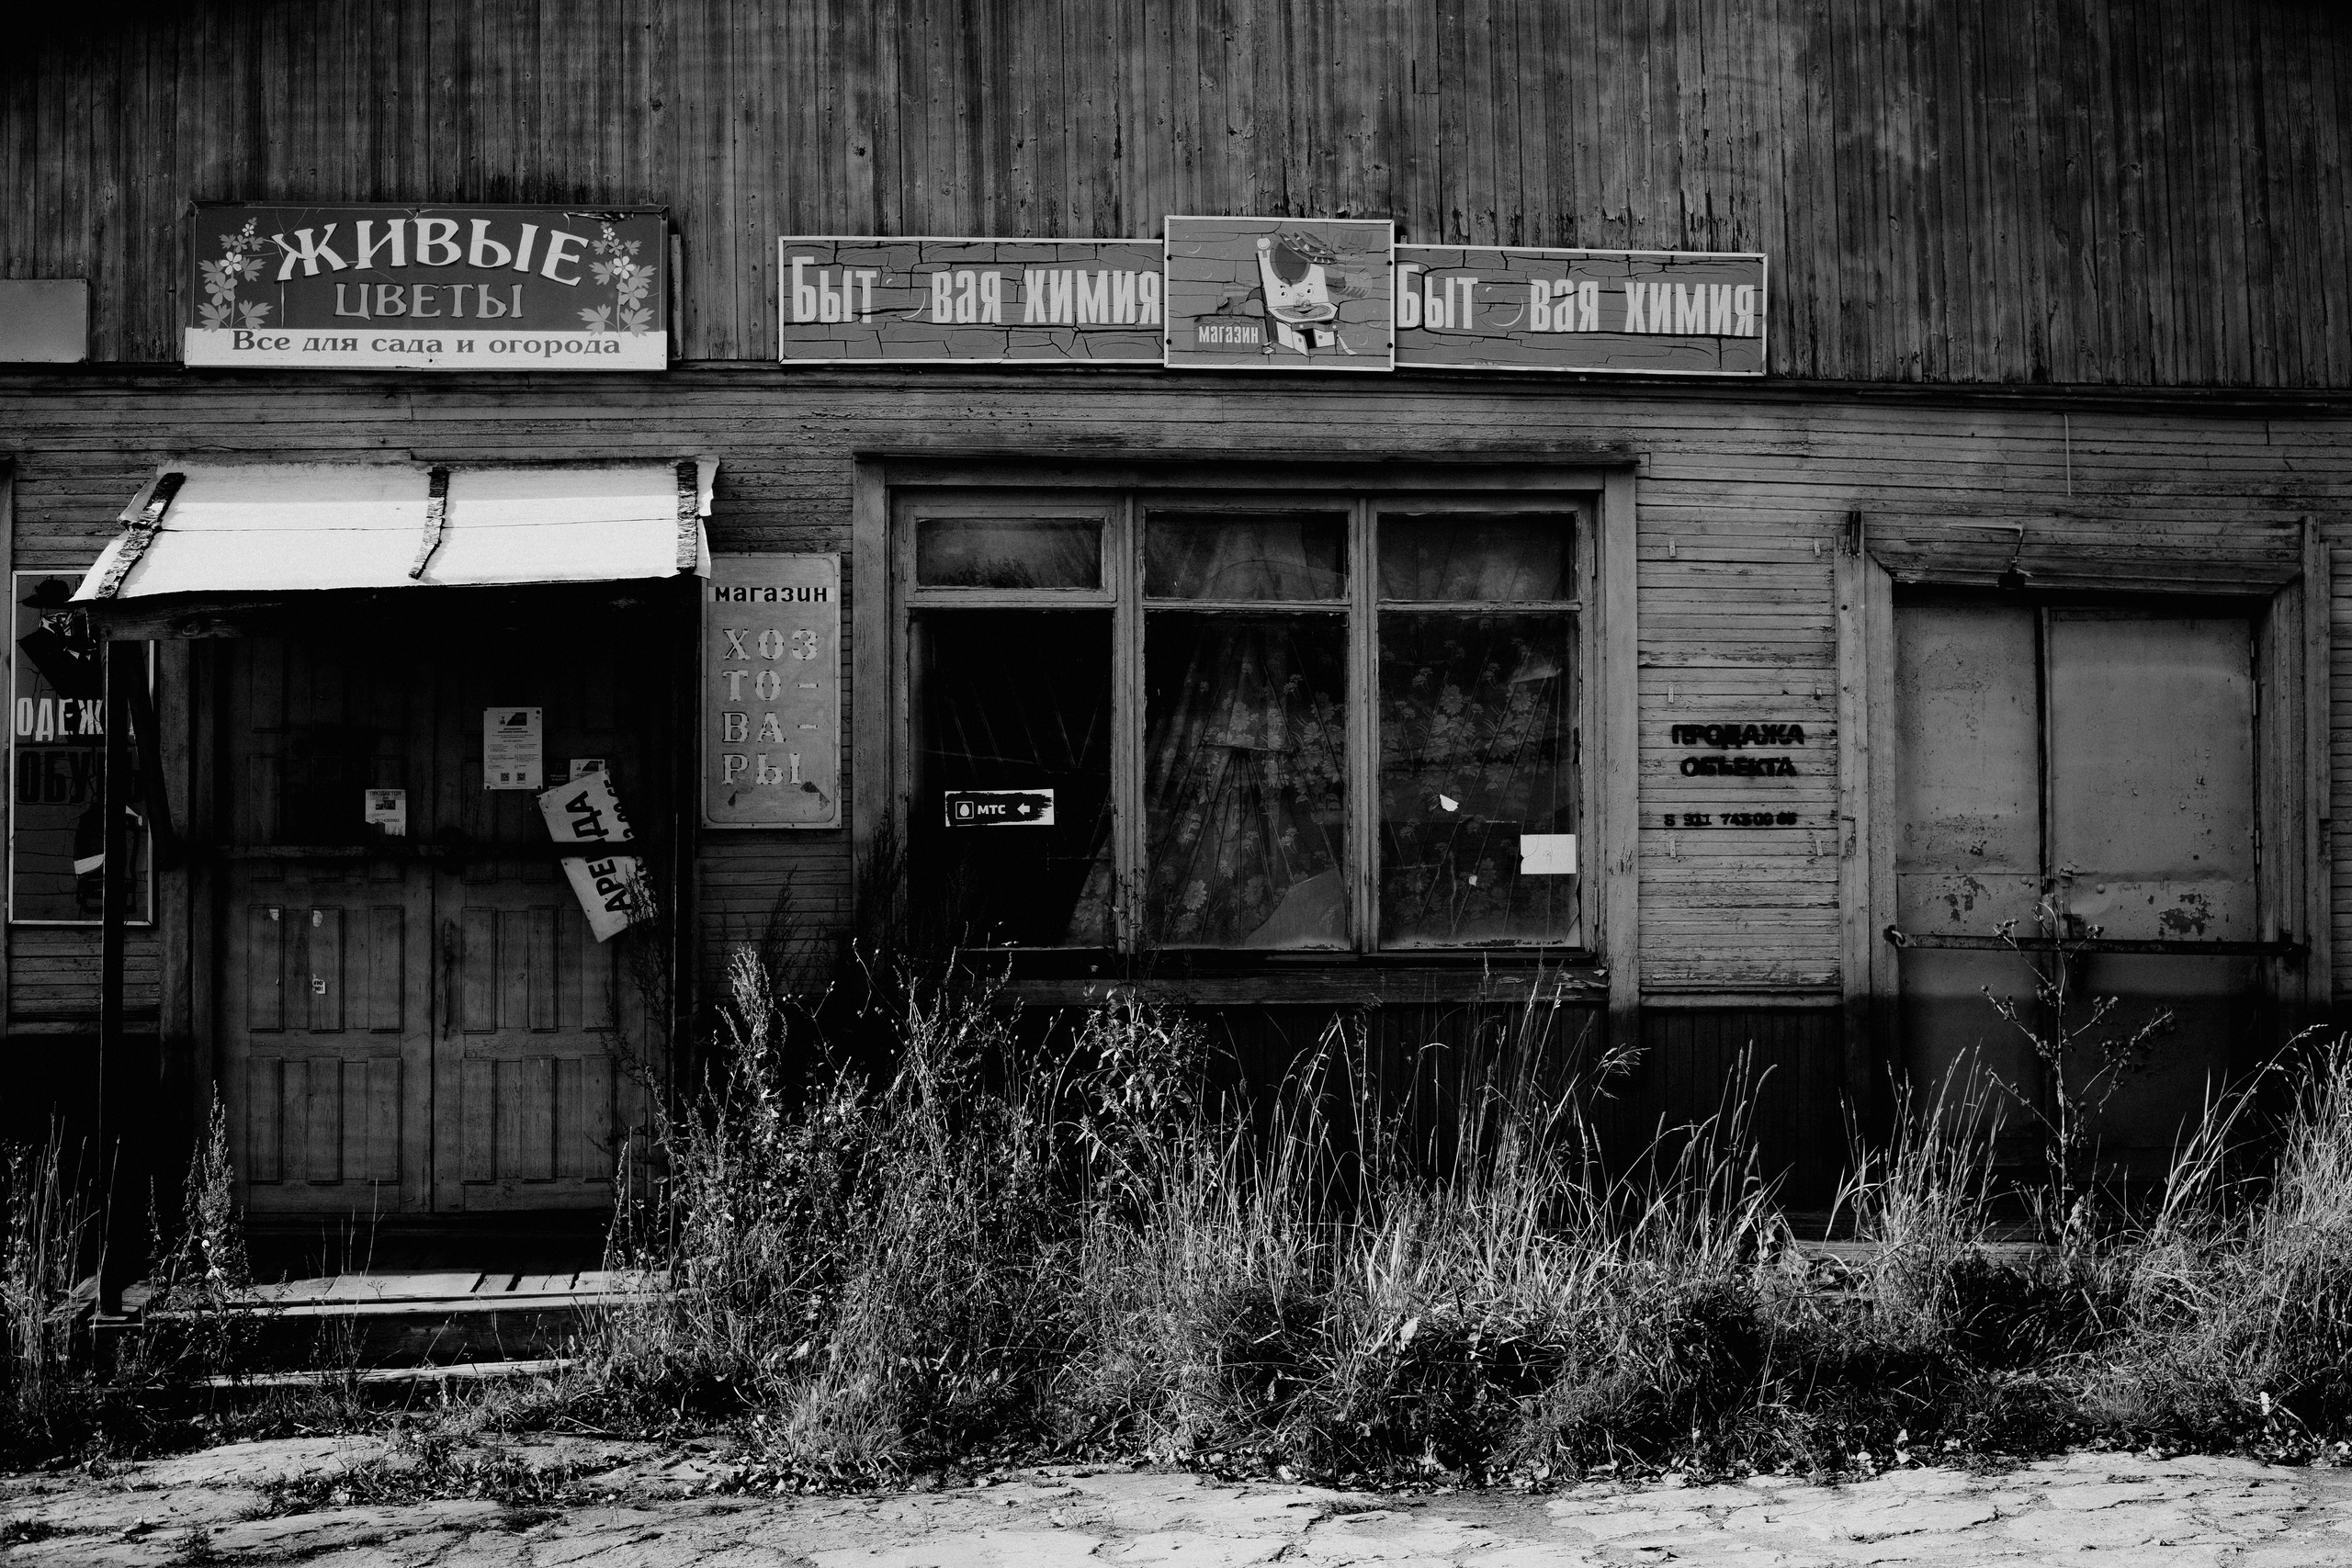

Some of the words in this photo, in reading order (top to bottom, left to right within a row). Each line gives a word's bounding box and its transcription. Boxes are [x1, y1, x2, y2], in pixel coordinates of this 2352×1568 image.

[271, 218, 590, 287] ЖИВЫЕ
[334, 283, 524, 321] ЦВЕТЫ
[232, 330, 290, 352] Все
[302, 336, 358, 353] для
[371, 336, 444, 355] сада
[457, 339, 475, 354] и
[488, 338, 621, 359] огорода
[1198, 325, 1259, 344] магазин
[715, 587, 827, 603] магазин
[722, 628, 819, 660] ХОЗ
[17, 697, 135, 741] ОДЕЖ
[1671, 724, 1804, 750] ПРОДАЖА
[722, 753, 801, 785] РЫ
[1679, 756, 1798, 777] ОБЪЕКТА
[977, 805, 1006, 815] МТС
[565, 791, 633, 912] АРЕДА
